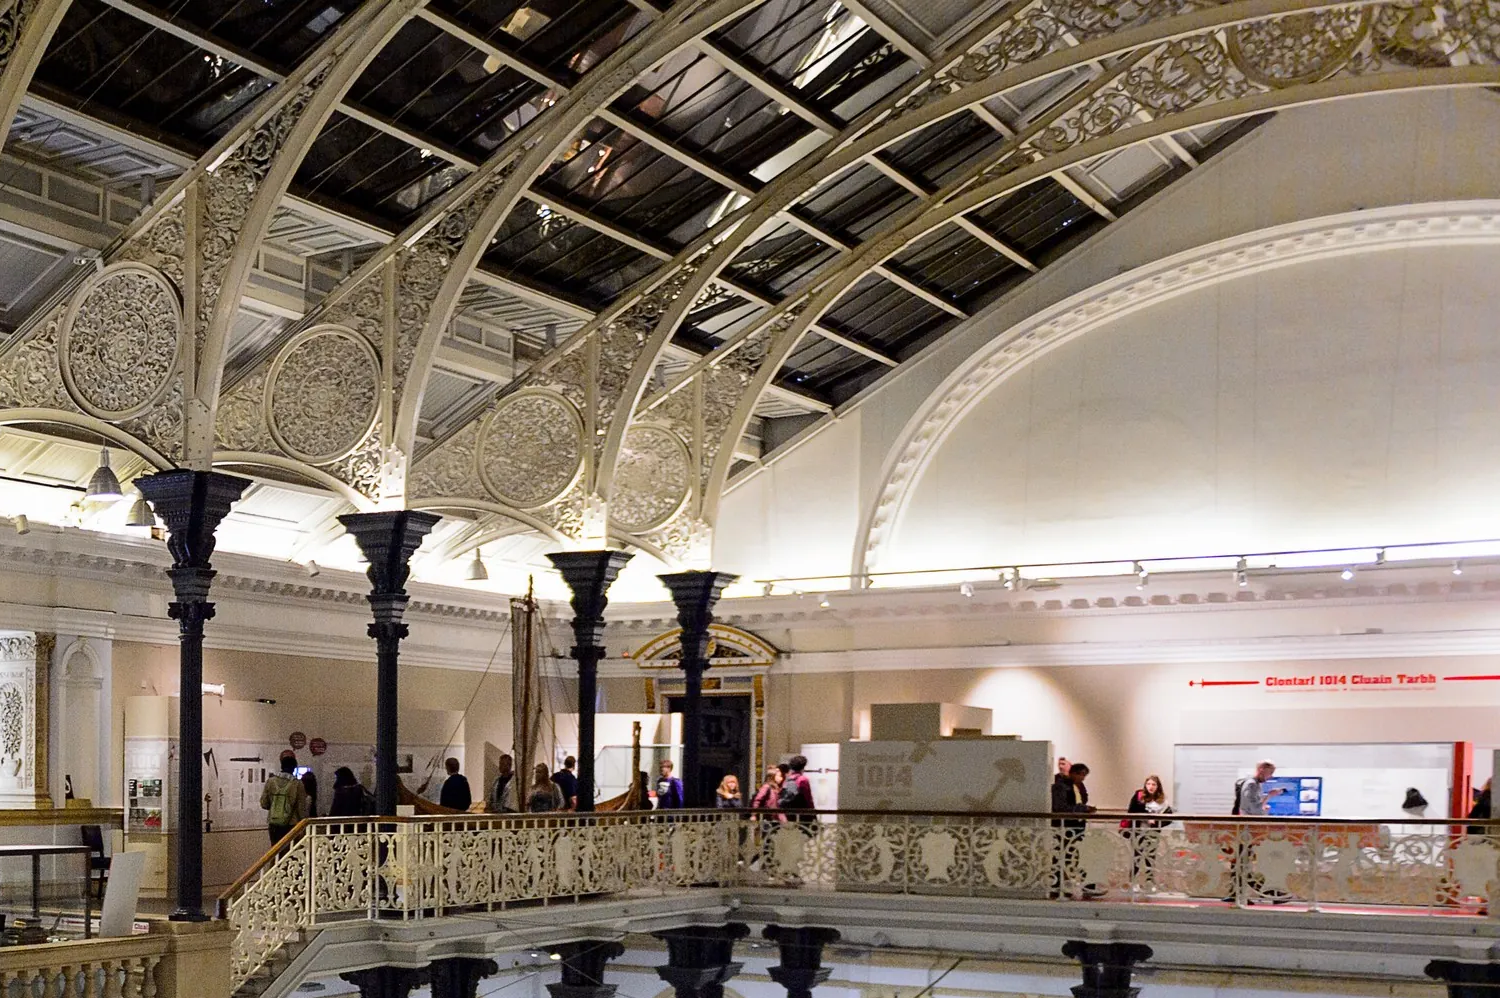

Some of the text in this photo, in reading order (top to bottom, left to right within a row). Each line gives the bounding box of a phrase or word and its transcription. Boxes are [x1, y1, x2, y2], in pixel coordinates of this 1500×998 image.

[1266, 673, 1436, 686] Clontarf 1014 Cluain Tarbh
